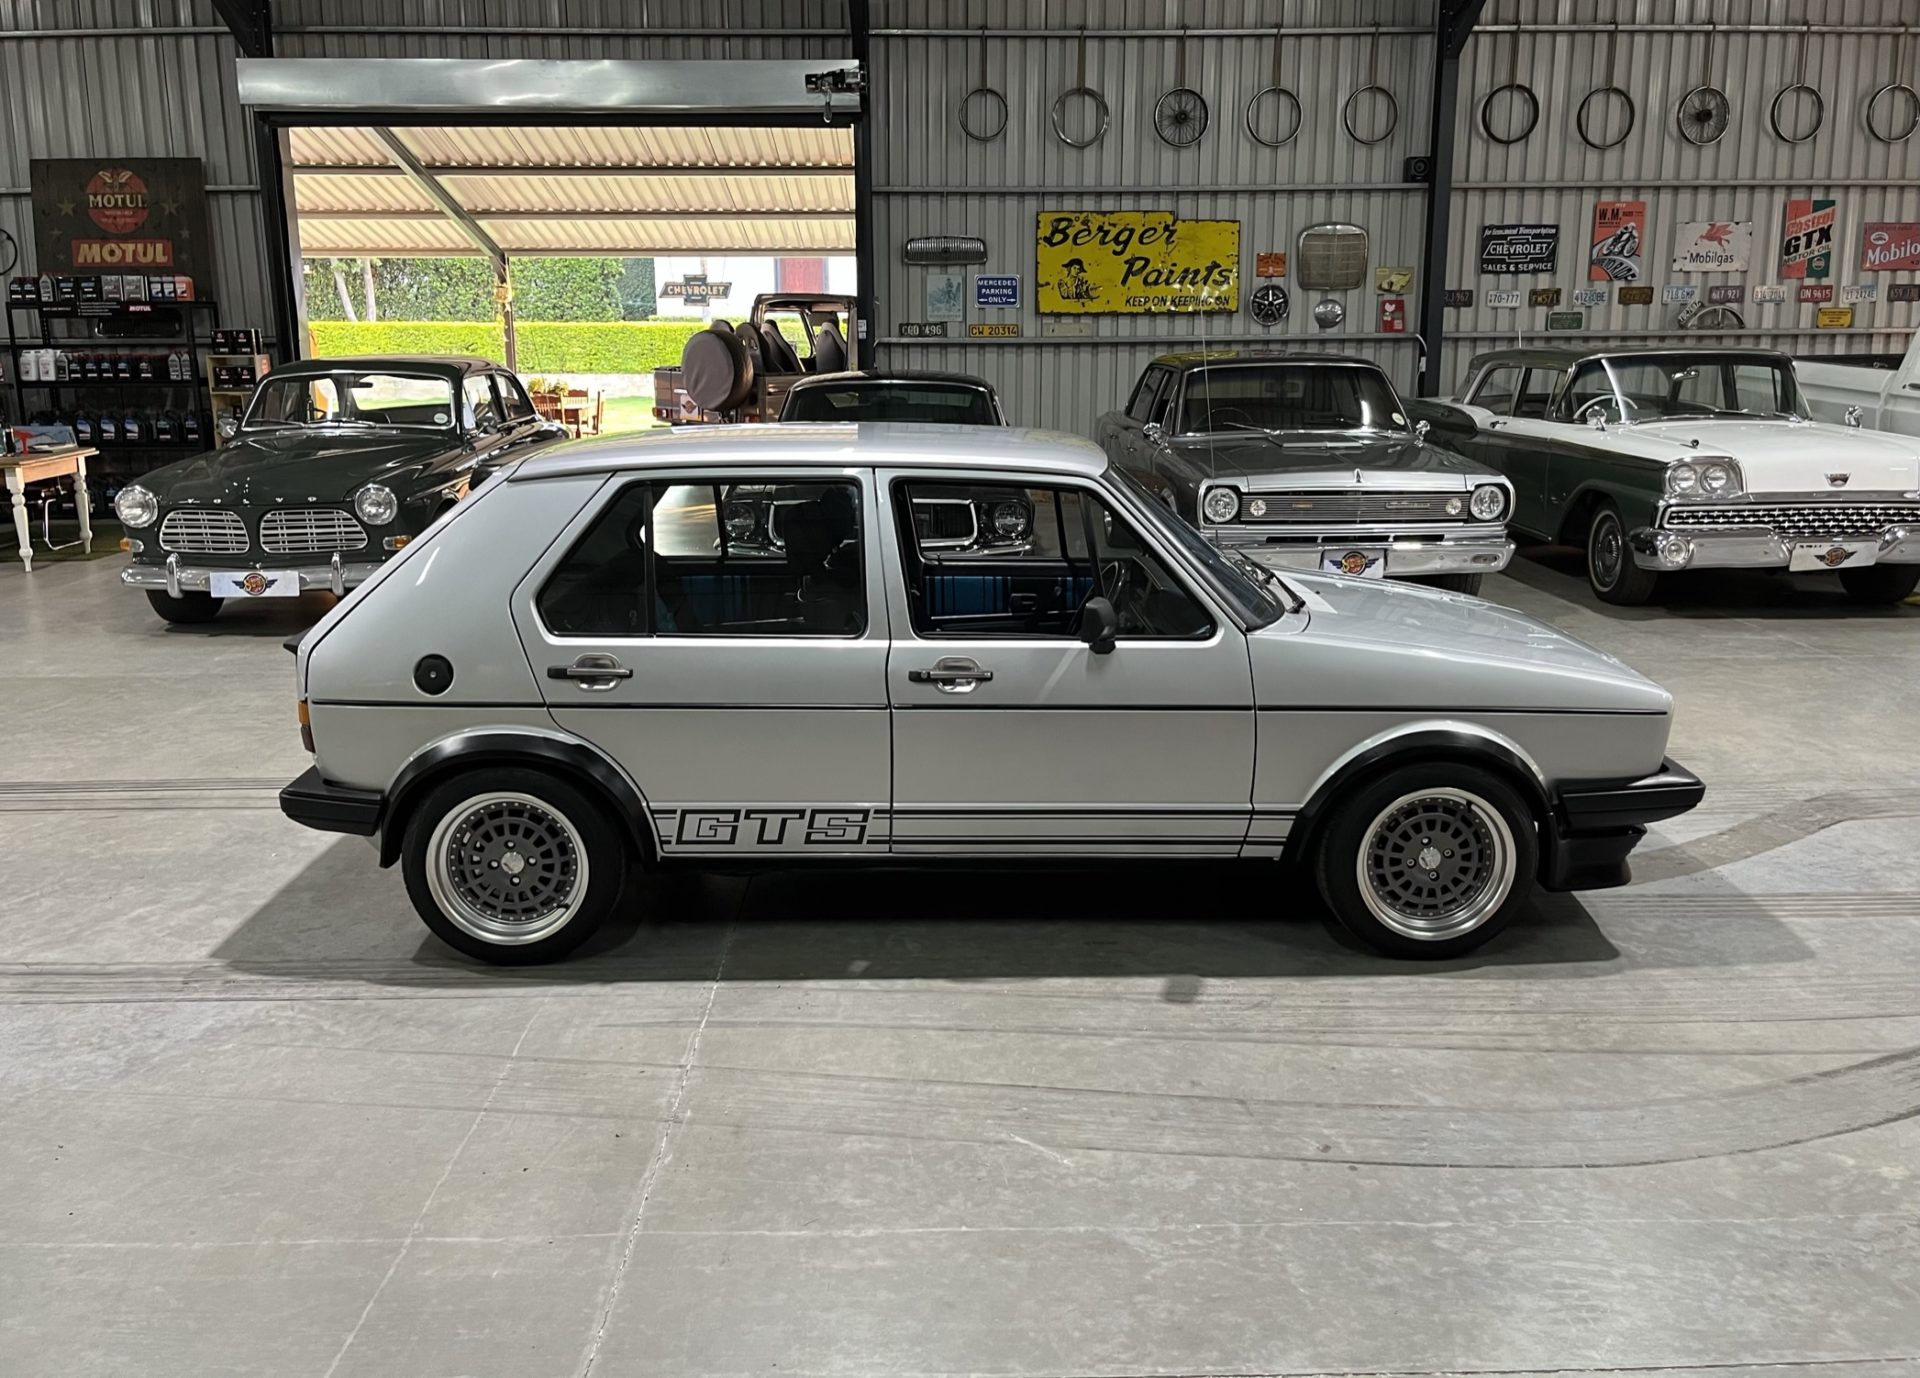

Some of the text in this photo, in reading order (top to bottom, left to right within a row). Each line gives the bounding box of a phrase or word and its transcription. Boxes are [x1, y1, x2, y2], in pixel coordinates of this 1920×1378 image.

[88, 194, 148, 208] MOTUL
[1599, 208, 1622, 221] W.M.
[1786, 209, 1836, 237] Castrol
[1043, 217, 1178, 256] Berger
[1519, 227, 1556, 237] Transportation
[1784, 224, 1833, 257] GTX
[77, 243, 168, 263] MOTUL
[1490, 244, 1548, 254] CHEVROLET
[1784, 245, 1832, 264] MOTOR OIL
[1689, 252, 1734, 267] Mobilgas
[1120, 256, 1234, 287] Paints
[1482, 262, 1553, 272] SALES & SERVICE
[667, 285, 725, 296] CHEVROLET
[1813, 288, 1832, 299] 9615
[1125, 296, 1150, 307] KEEP
[1152, 296, 1169, 307] ON
[1215, 295, 1230, 306] ON
[988, 326, 1017, 336] 20314
[675, 809, 871, 845] GTS
